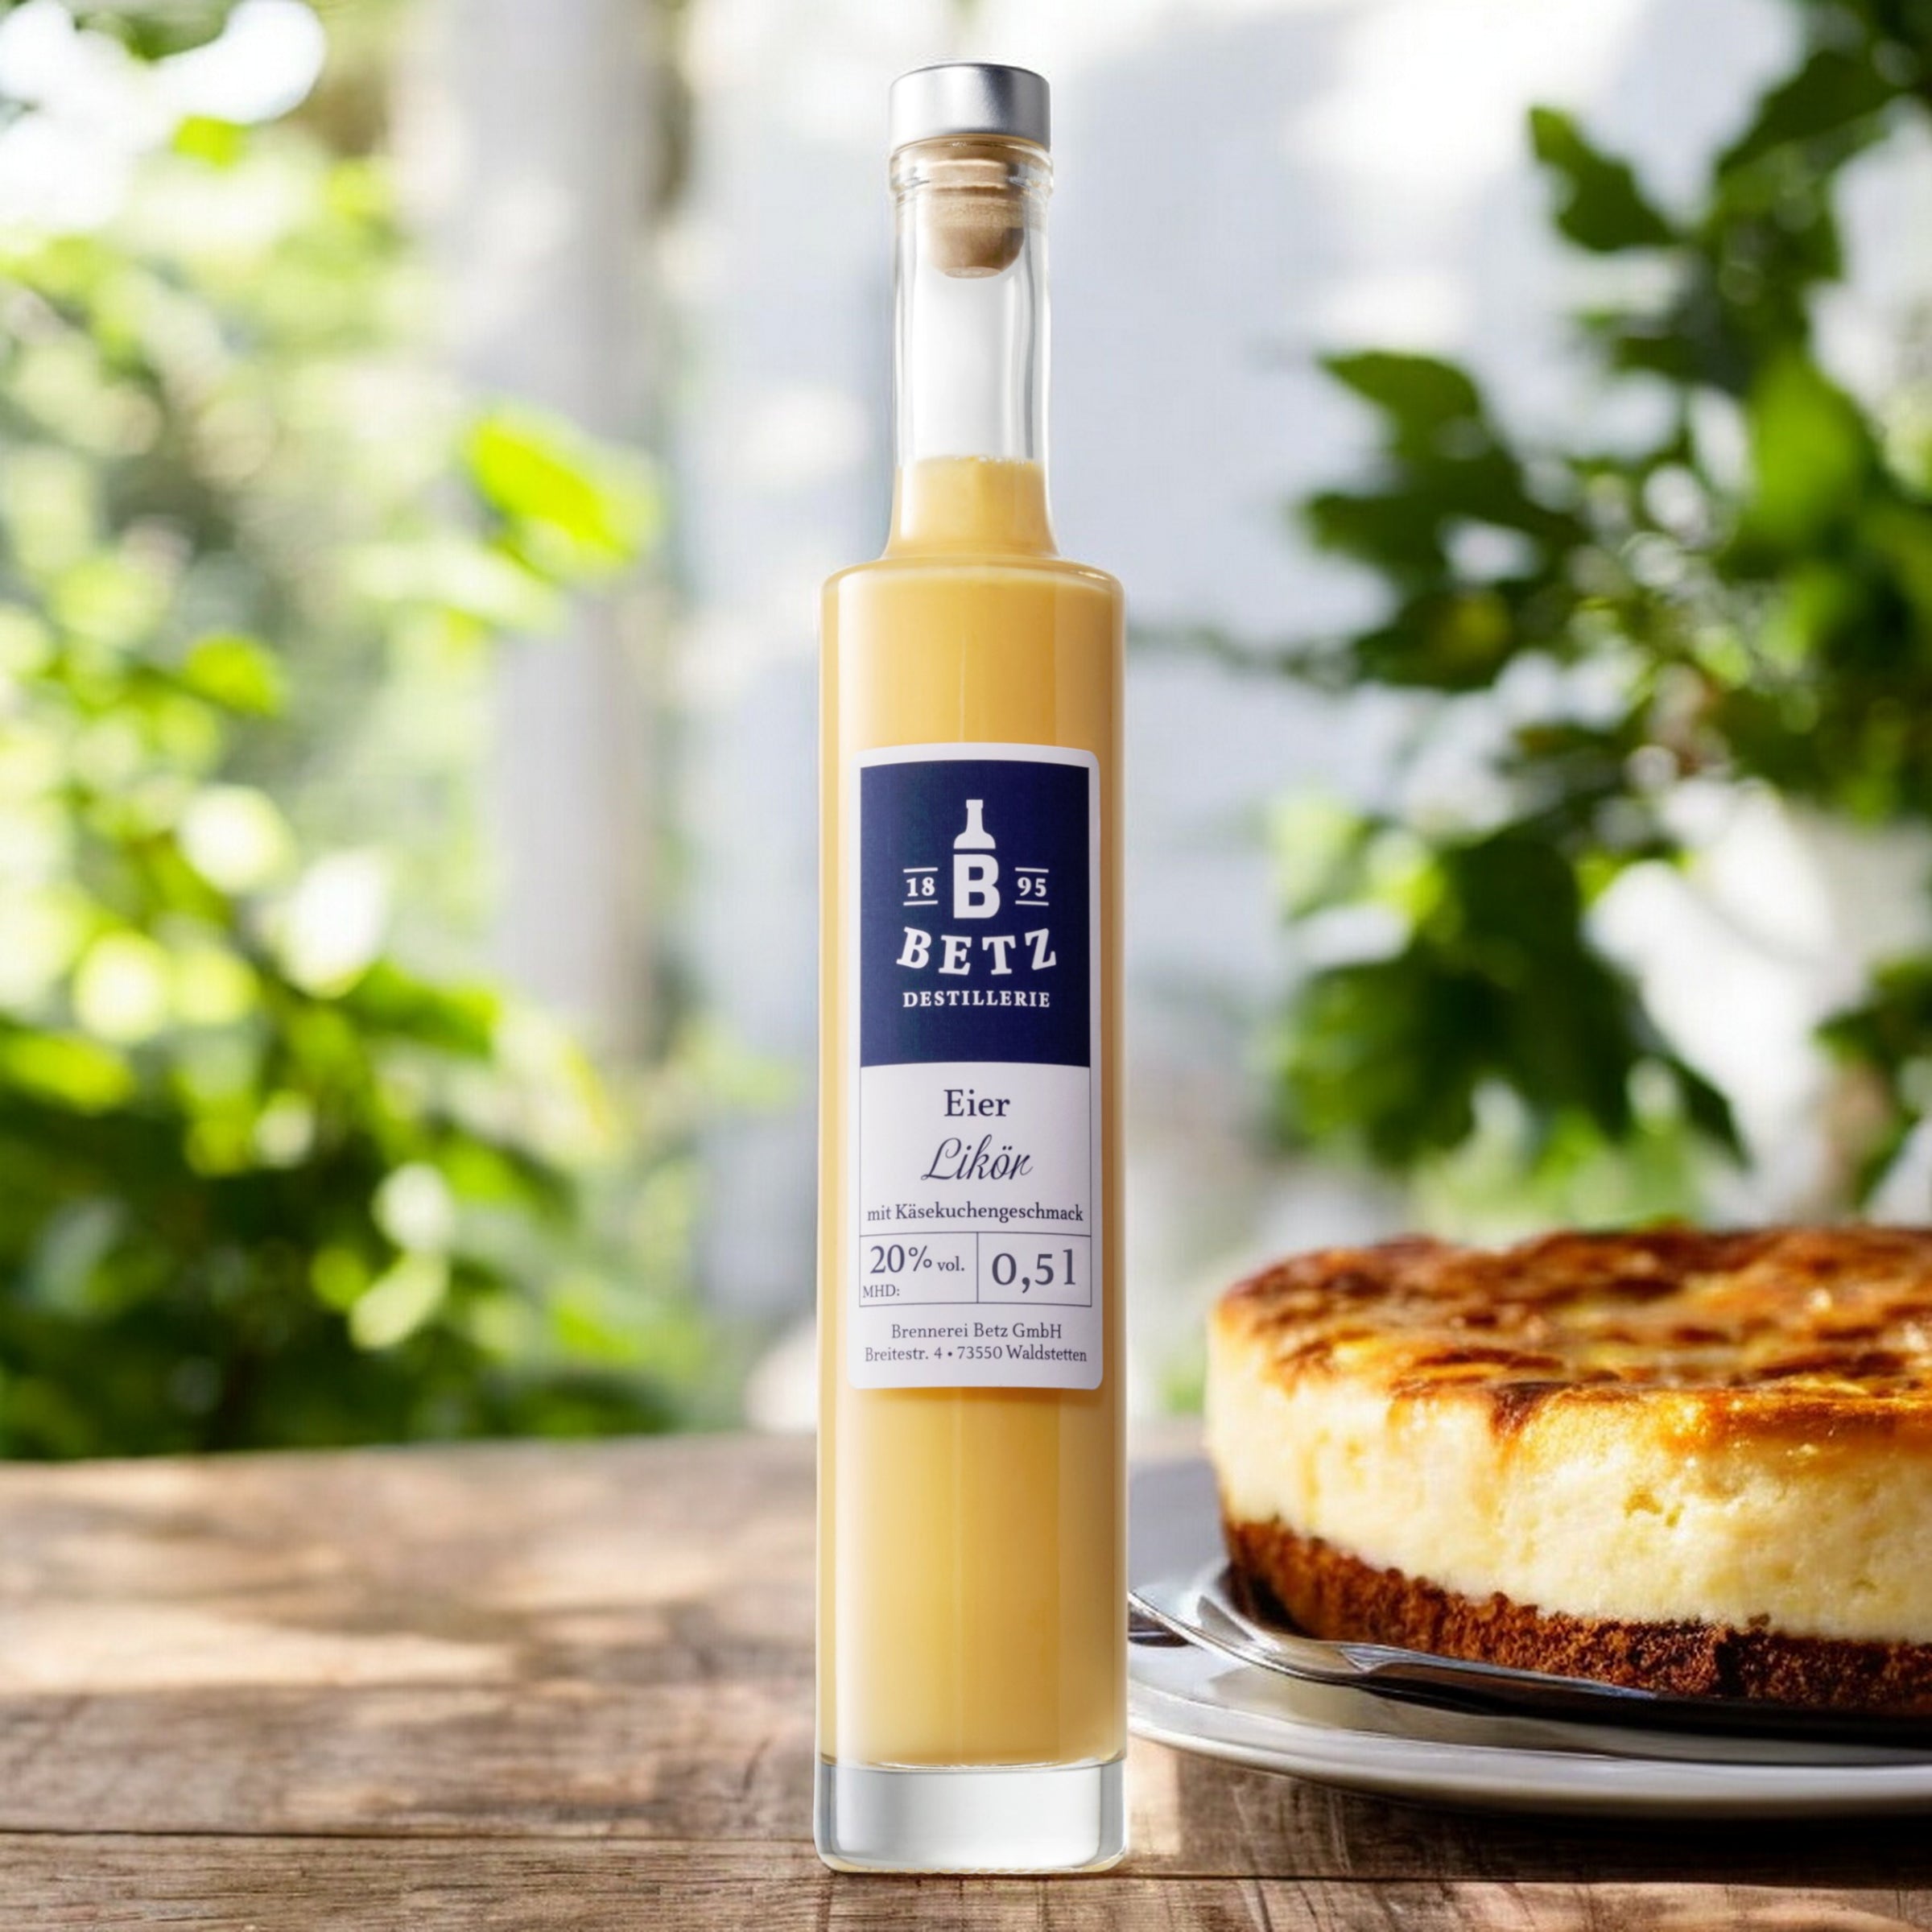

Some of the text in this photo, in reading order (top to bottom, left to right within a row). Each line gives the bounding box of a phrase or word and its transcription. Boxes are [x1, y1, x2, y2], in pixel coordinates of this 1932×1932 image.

[906, 877, 935, 898] 18
[1017, 877, 1046, 898] 95
[896, 927, 1057, 976] BETZ
[902, 990, 1051, 1008] DESTILLERIE
[943, 1088, 1010, 1117] Eier
[920, 1133, 1034, 1180] Likör
[867, 1201, 1084, 1223] mit Käsekuchengeschmack
[869, 1244, 965, 1274] 20% vol.
[862, 1284, 900, 1298] MHD:
[891, 1323, 1062, 1339] Brennerei Betz GmbH
[865, 1345, 1087, 1362] Breitestr. 4 73550 Waldstetten
